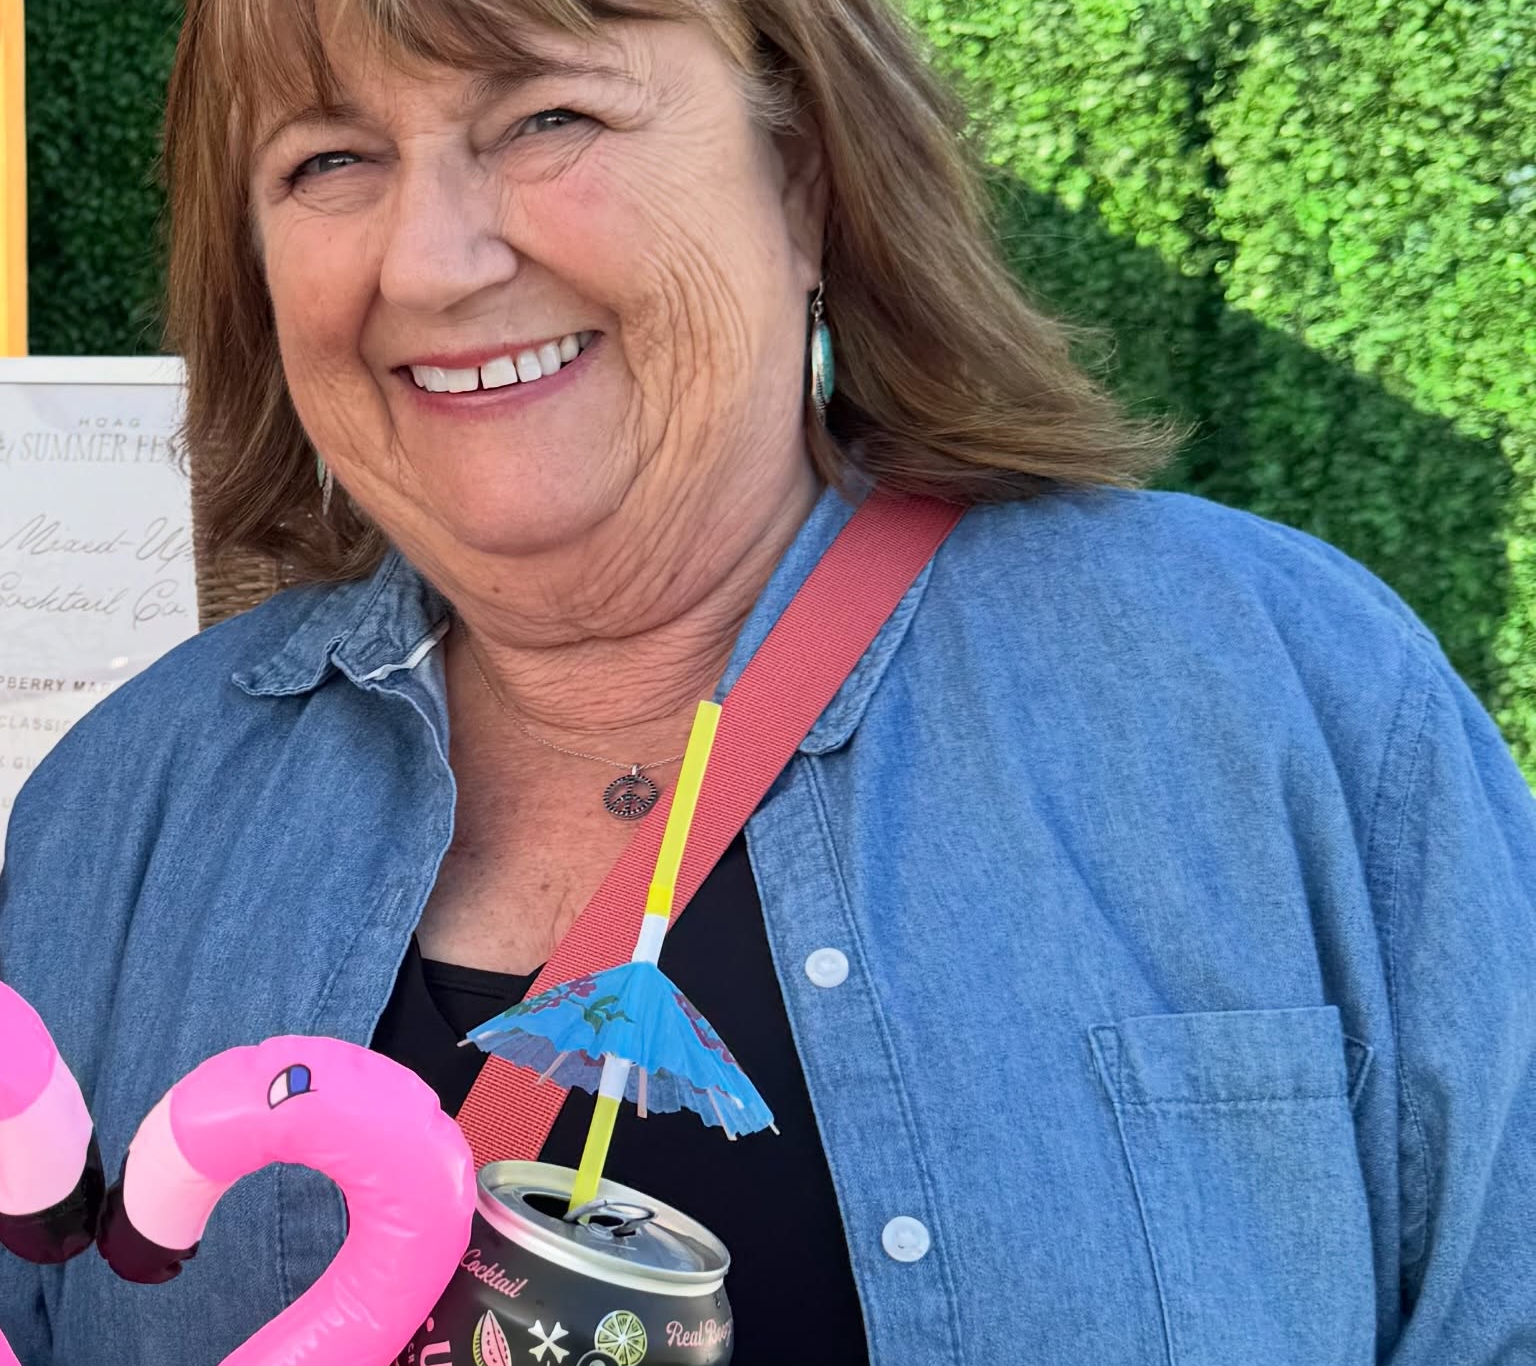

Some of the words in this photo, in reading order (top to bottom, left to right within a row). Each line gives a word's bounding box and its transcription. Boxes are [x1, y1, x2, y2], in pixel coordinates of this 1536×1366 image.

[78, 417, 142, 429] HOAG
[20, 432, 128, 464] SUMMER
[132, 579, 190, 630] Co.
[460, 1249, 528, 1298] Cocktail
[666, 1320, 704, 1347] Real
